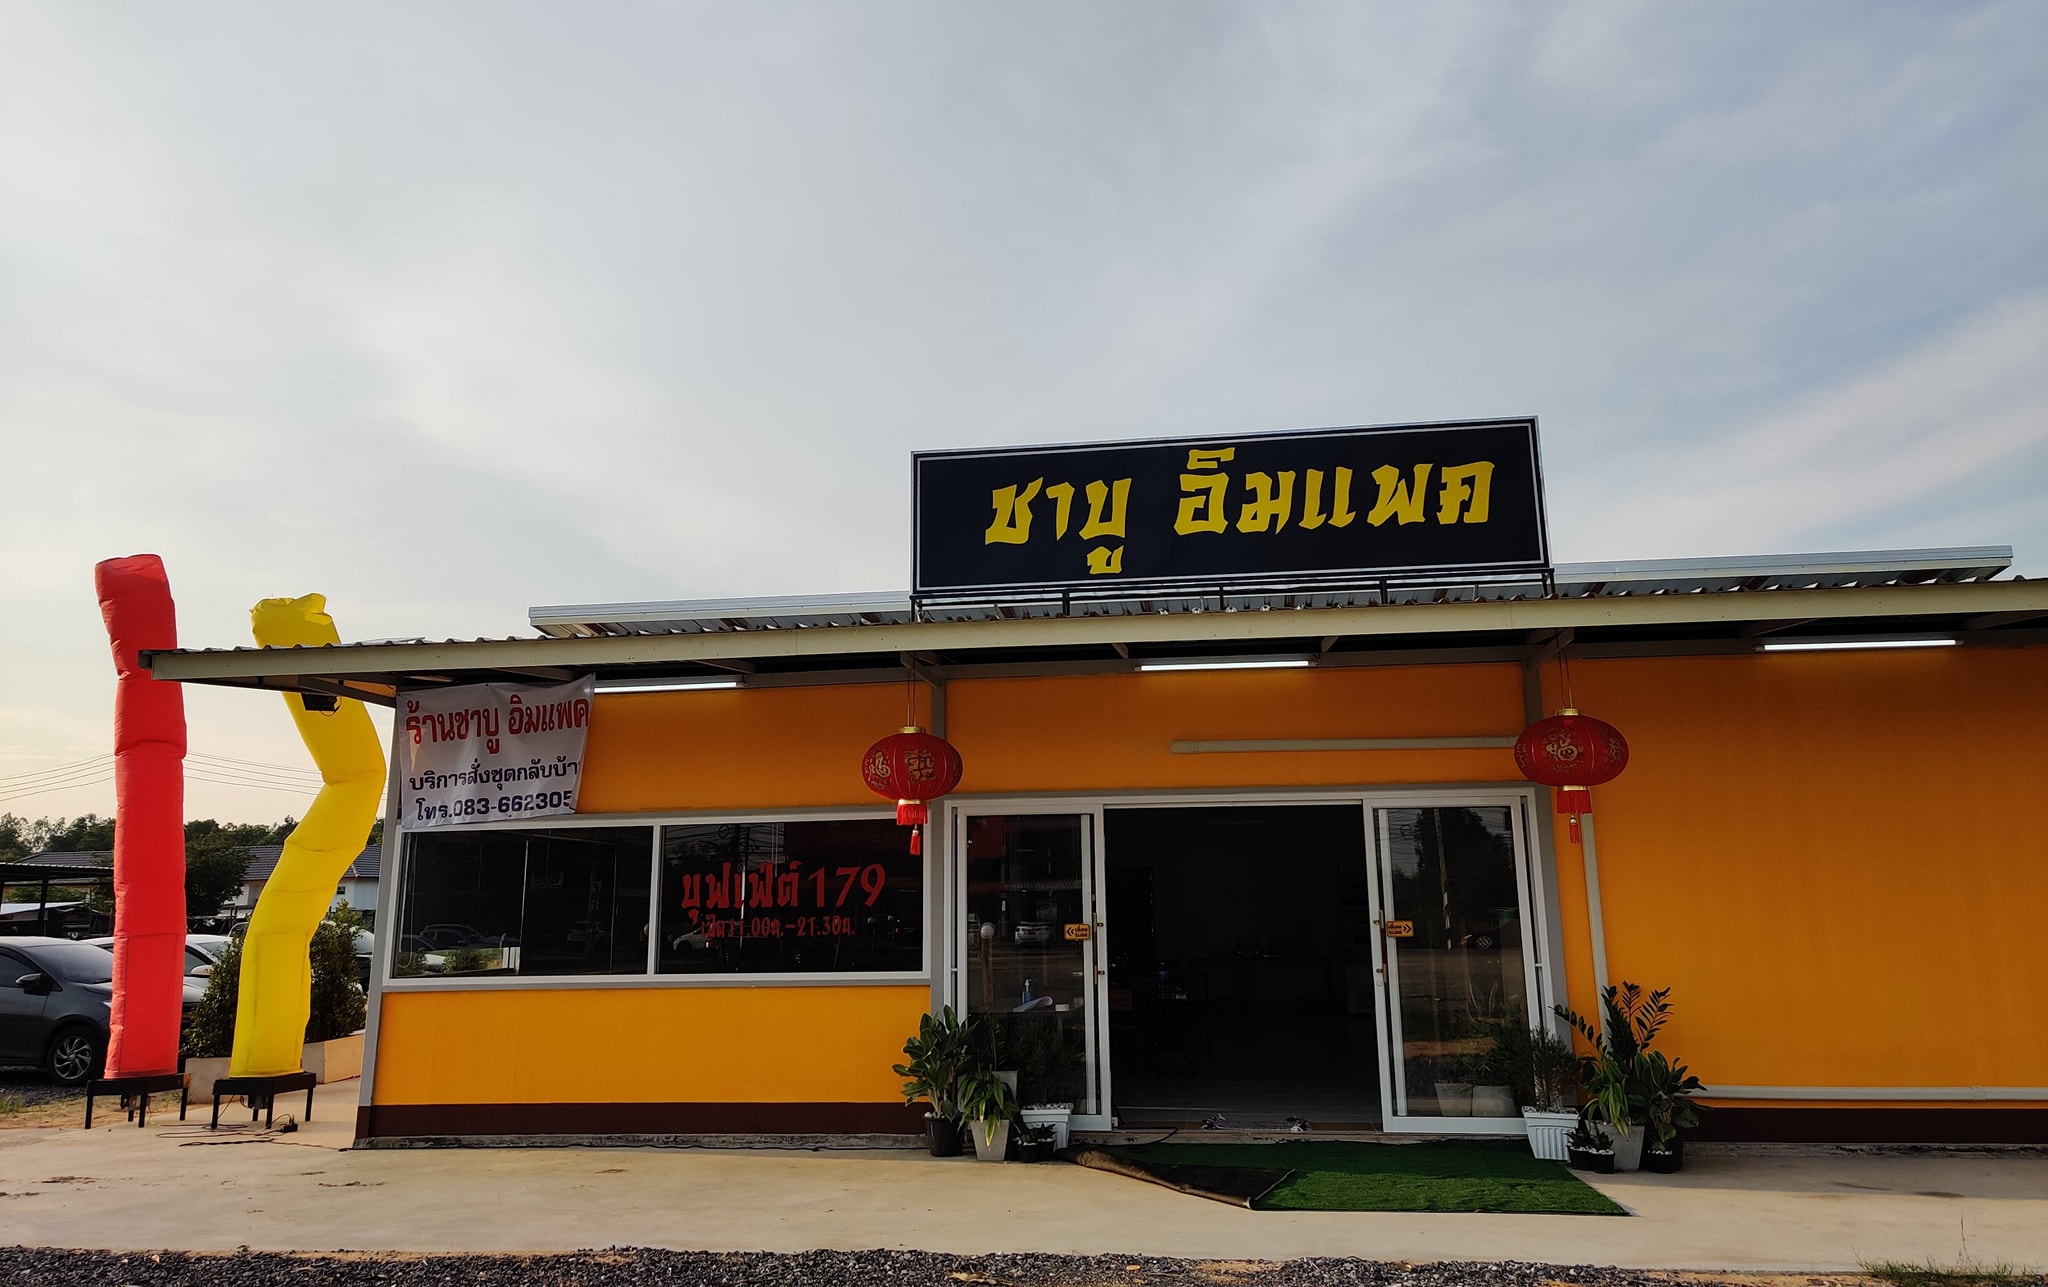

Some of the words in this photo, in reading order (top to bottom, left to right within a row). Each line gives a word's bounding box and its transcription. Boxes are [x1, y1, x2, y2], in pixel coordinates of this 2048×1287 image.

[985, 477, 1132, 575] ชาบู
[405, 700, 500, 754] ร้านชาบู
[508, 694, 589, 734] อิมแพค
[409, 755, 580, 791] บริการสั่งชุดกลับบ้า
[808, 863, 887, 908] 179
